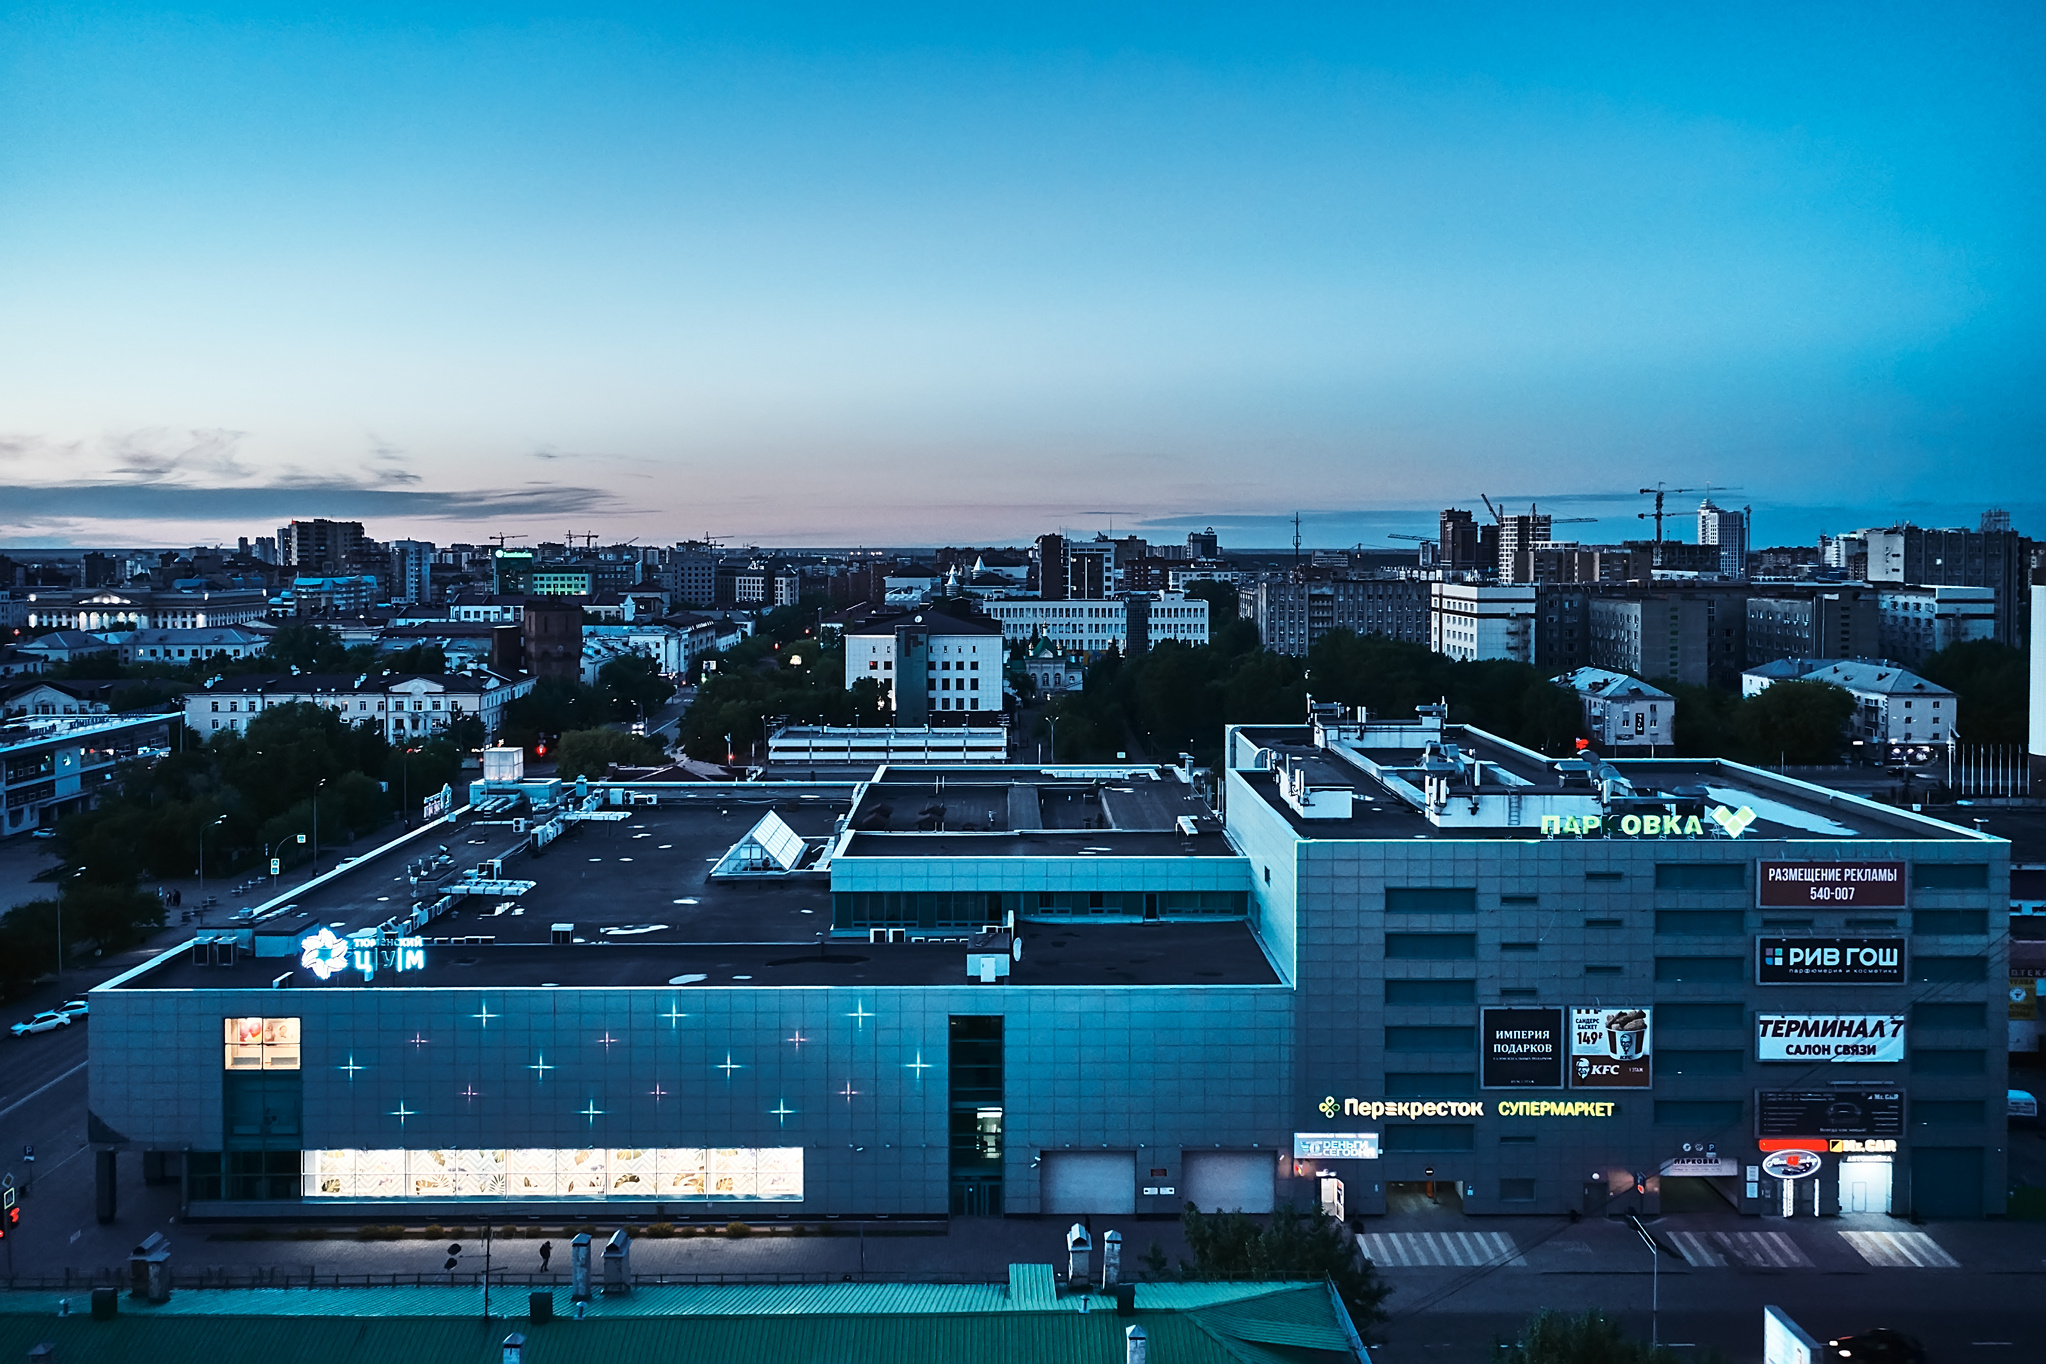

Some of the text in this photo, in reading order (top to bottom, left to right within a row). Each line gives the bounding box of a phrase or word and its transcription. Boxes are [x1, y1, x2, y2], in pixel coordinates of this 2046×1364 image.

[1540, 814, 1703, 836] ПАРКОВКА
[1768, 868, 1897, 883] РАЗМЕЩЕНИЕ РЕКЛАМЫ
[1810, 887, 1855, 900] 540-007
[1789, 948, 1898, 966] РИВ ГОШ
[1495, 1030, 1550, 1039] ИМПЕРИЯ
[1759, 1019, 1905, 1037] ТЕРМИНАЛ 7
[1493, 1044, 1553, 1055] ПОДАРКОВ
[1785, 1044, 1876, 1056] САЛОН СВЯЗИ
[1591, 1064, 1620, 1075] KFC
[1344, 1098, 1615, 1120] Перекресток СУПЕРМАРКЕТ
